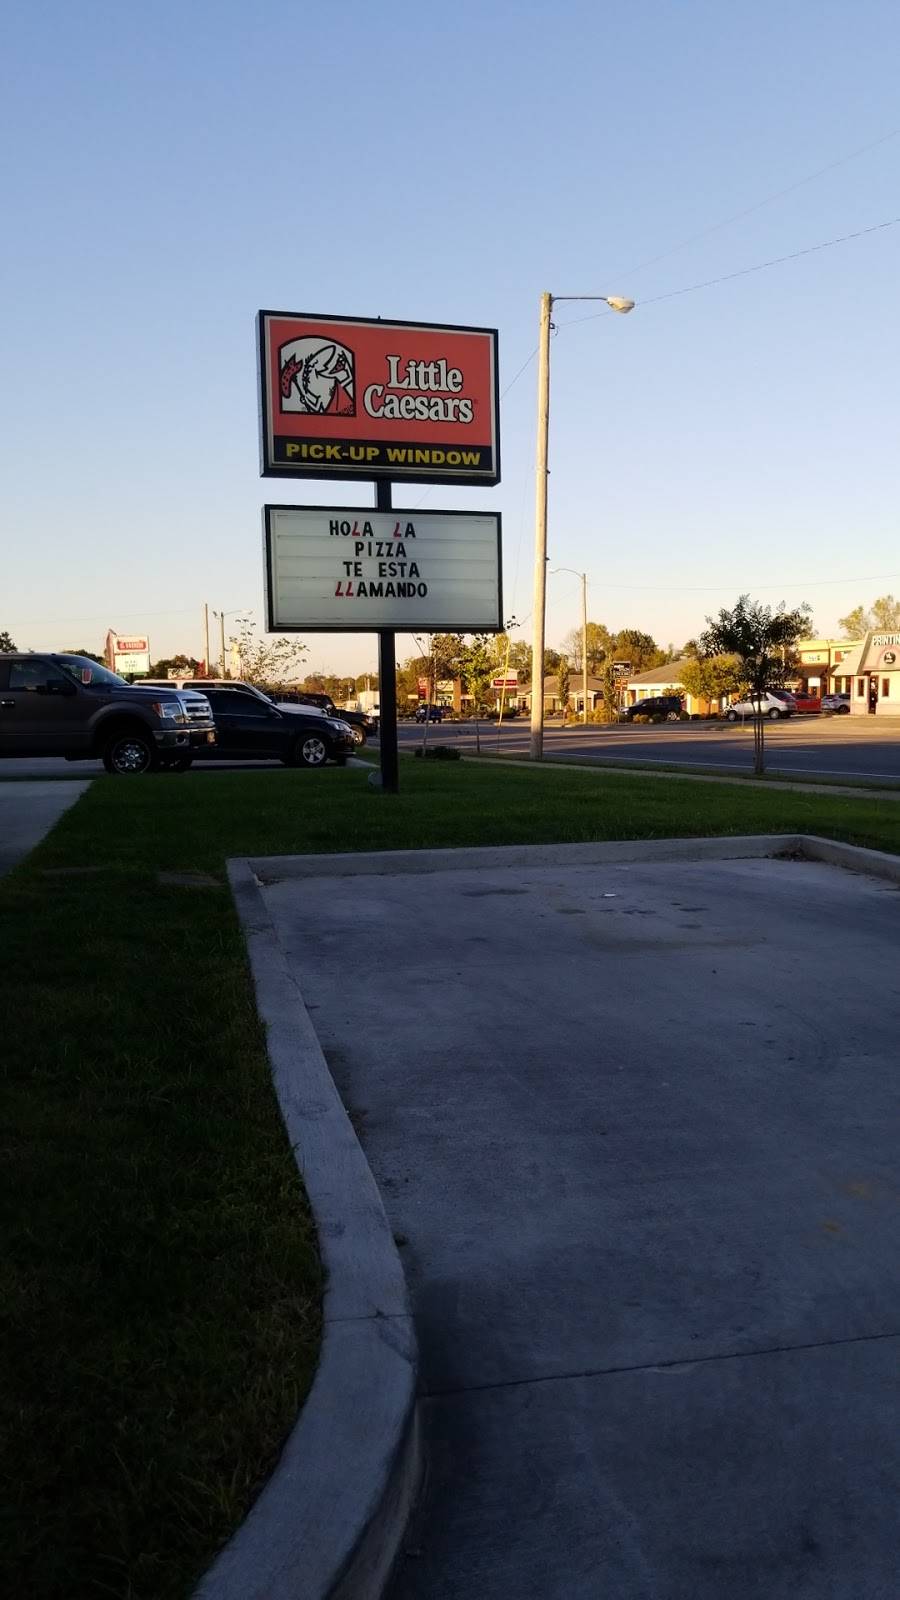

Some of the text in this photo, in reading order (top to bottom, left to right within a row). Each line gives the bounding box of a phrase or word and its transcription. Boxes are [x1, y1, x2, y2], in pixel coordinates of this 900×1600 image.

[386, 355, 463, 393] Little
[363, 384, 474, 423] Caesars
[286, 443, 481, 465] PICK-UP WINDOW
[329, 520, 416, 538] HOLA LA
[355, 541, 407, 557] PIZZA
[343, 561, 420, 578] TE ESTA
[335, 581, 428, 598] LLAMANDO
